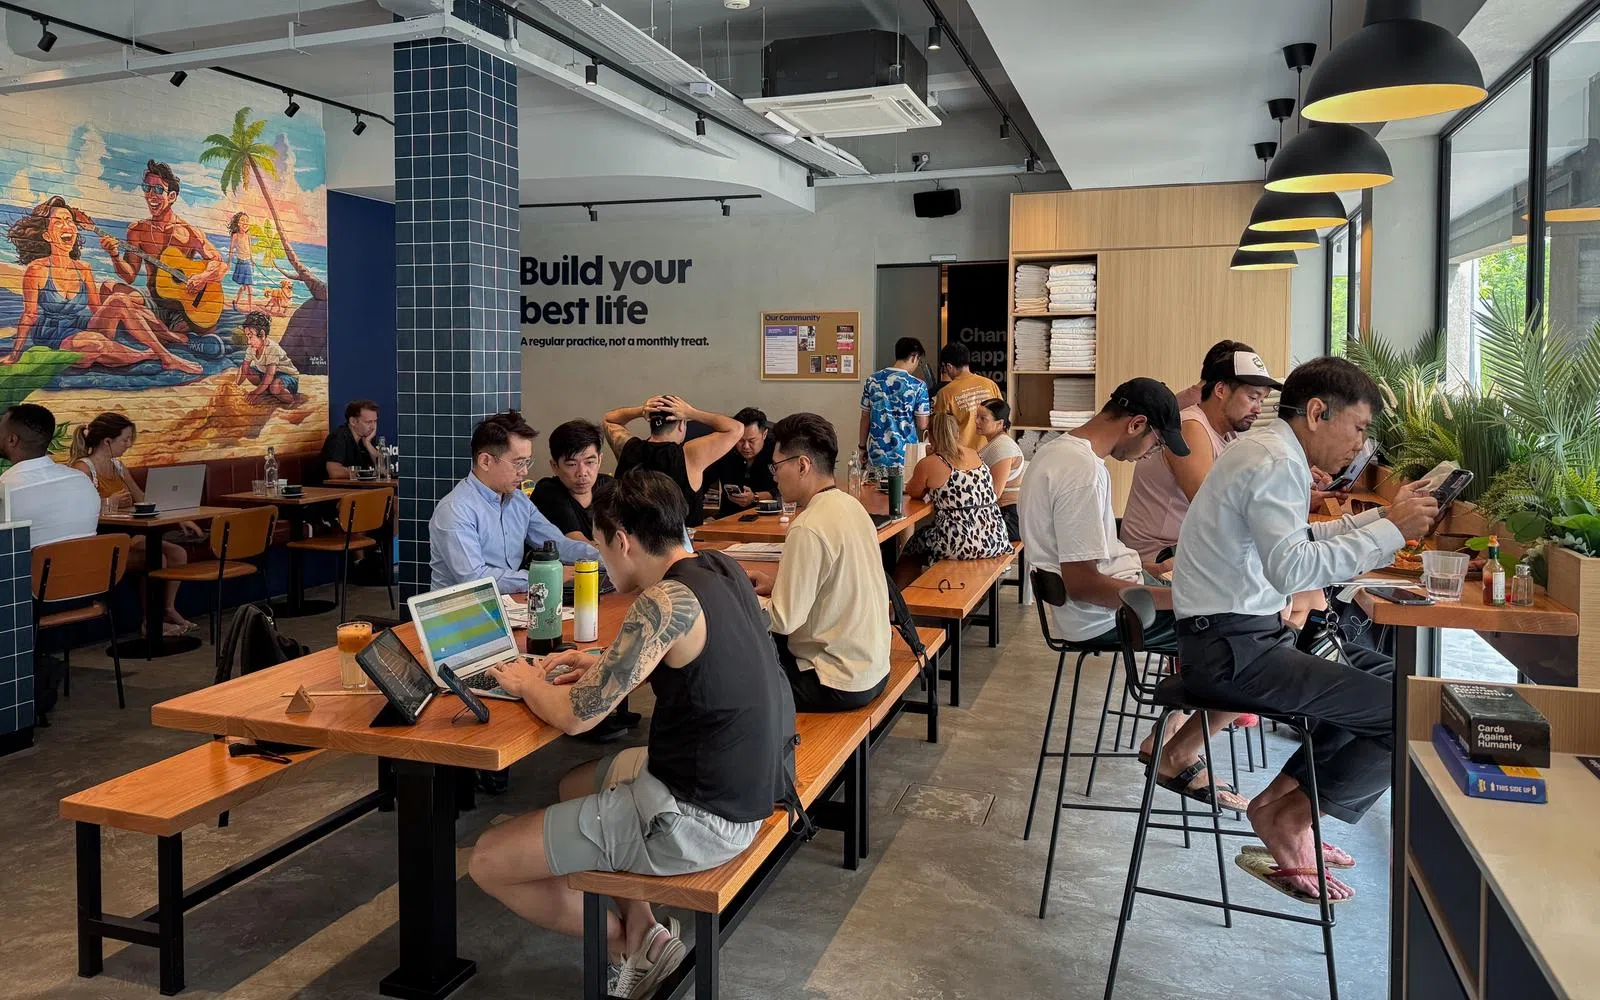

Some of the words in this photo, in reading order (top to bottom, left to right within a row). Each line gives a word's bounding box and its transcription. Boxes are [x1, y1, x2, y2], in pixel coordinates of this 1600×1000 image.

[520, 254, 603, 286] Build
[608, 258, 693, 292] your
[520, 295, 589, 325] best
[596, 294, 648, 325] life
[779, 314, 821, 322] Community
[520, 337, 528, 346] A
[528, 336, 566, 348] regular
[566, 336, 608, 348] practice,
[609, 336, 627, 346] not
[627, 338, 635, 346] a
[636, 336, 680, 348] monthly
[680, 336, 709, 346] treat.
[1477, 724, 1505, 733] Cards
[1478, 732, 1513, 742] Against
[1477, 740, 1522, 751] Humanity
